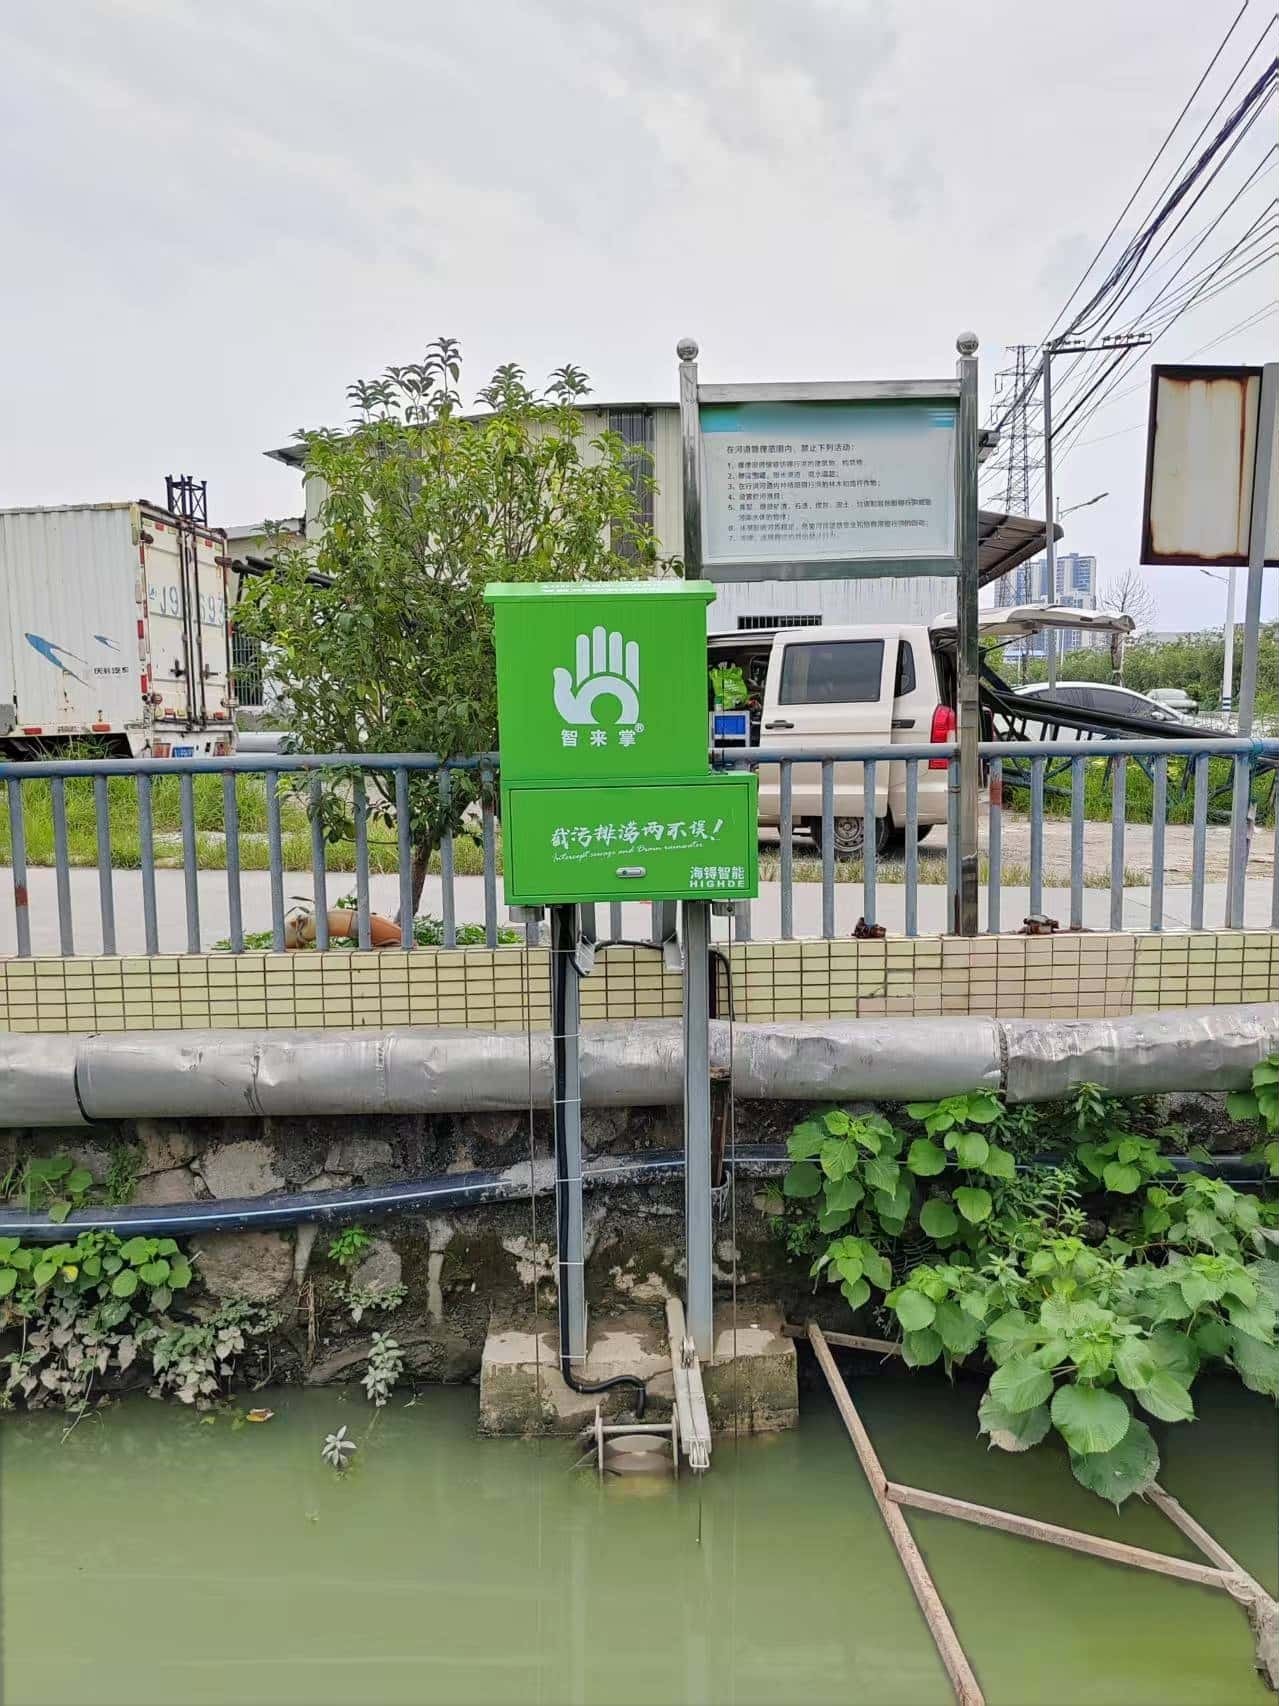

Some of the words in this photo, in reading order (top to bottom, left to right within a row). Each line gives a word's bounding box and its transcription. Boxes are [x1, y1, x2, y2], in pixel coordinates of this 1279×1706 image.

[561, 729, 636, 747] 智来掌
[689, 880, 745, 888] HIGHDE
